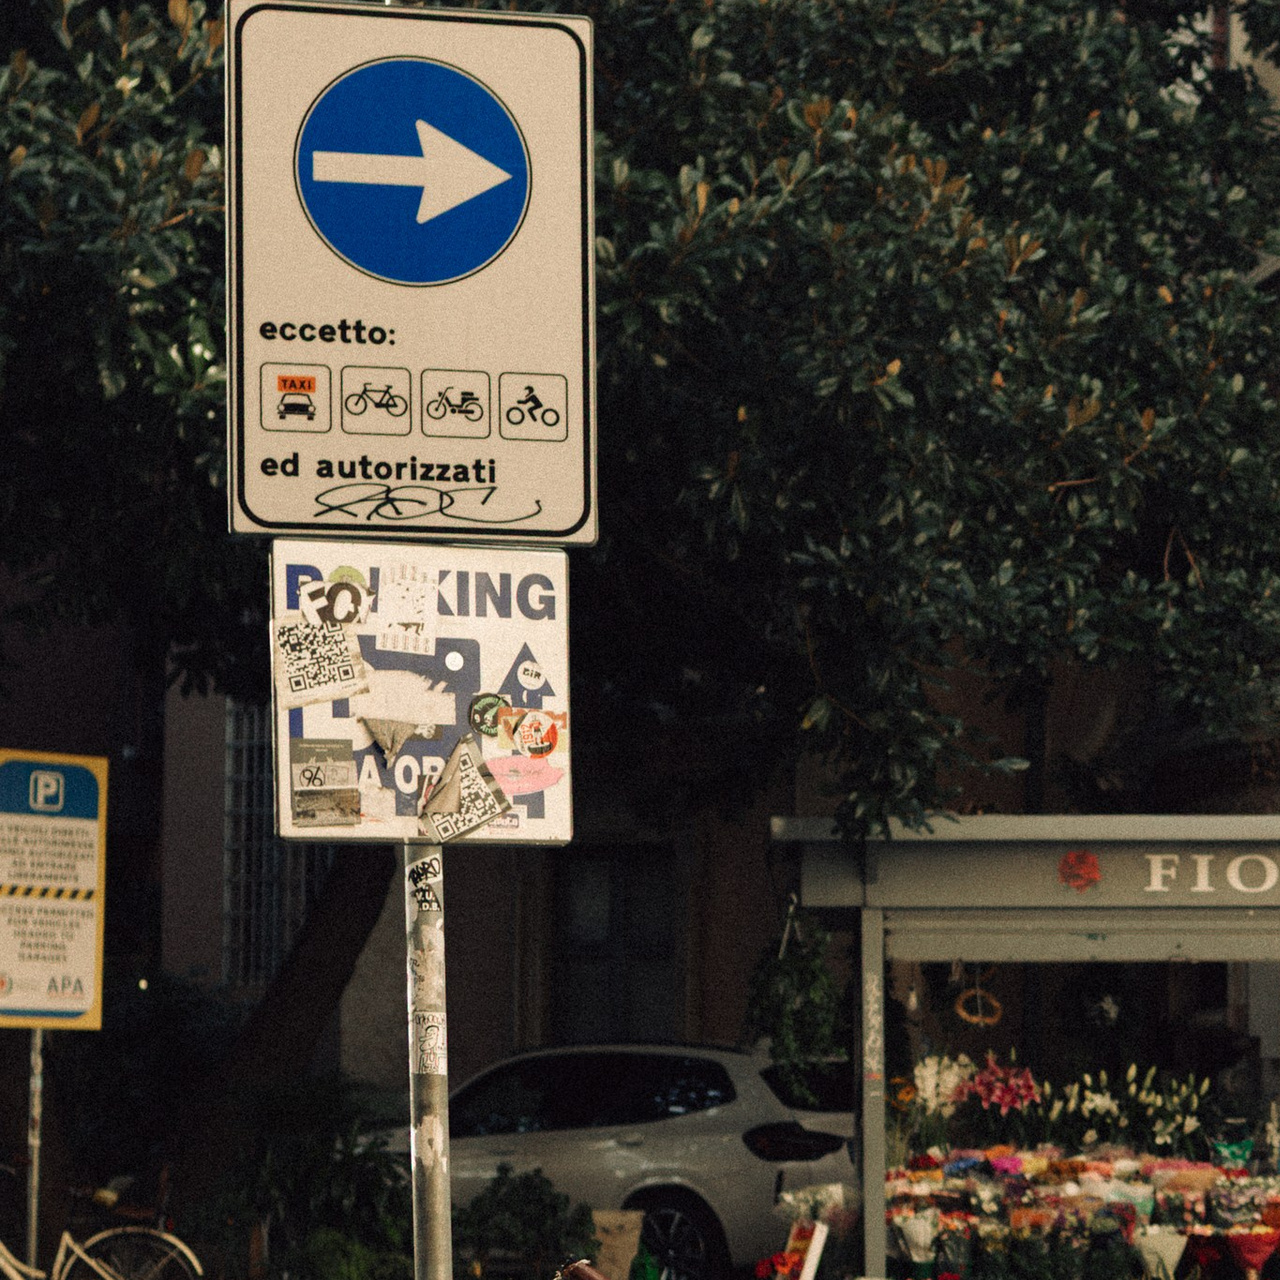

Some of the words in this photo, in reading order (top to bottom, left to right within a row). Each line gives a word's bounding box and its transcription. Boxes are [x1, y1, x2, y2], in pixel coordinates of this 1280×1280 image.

[259, 319, 396, 346] eccetto:
[280, 378, 313, 391] TAXI
[260, 453, 300, 477] ed
[316, 454, 497, 484] autorizzati
[37, 774, 57, 807] P
[47, 975, 85, 994] APA
